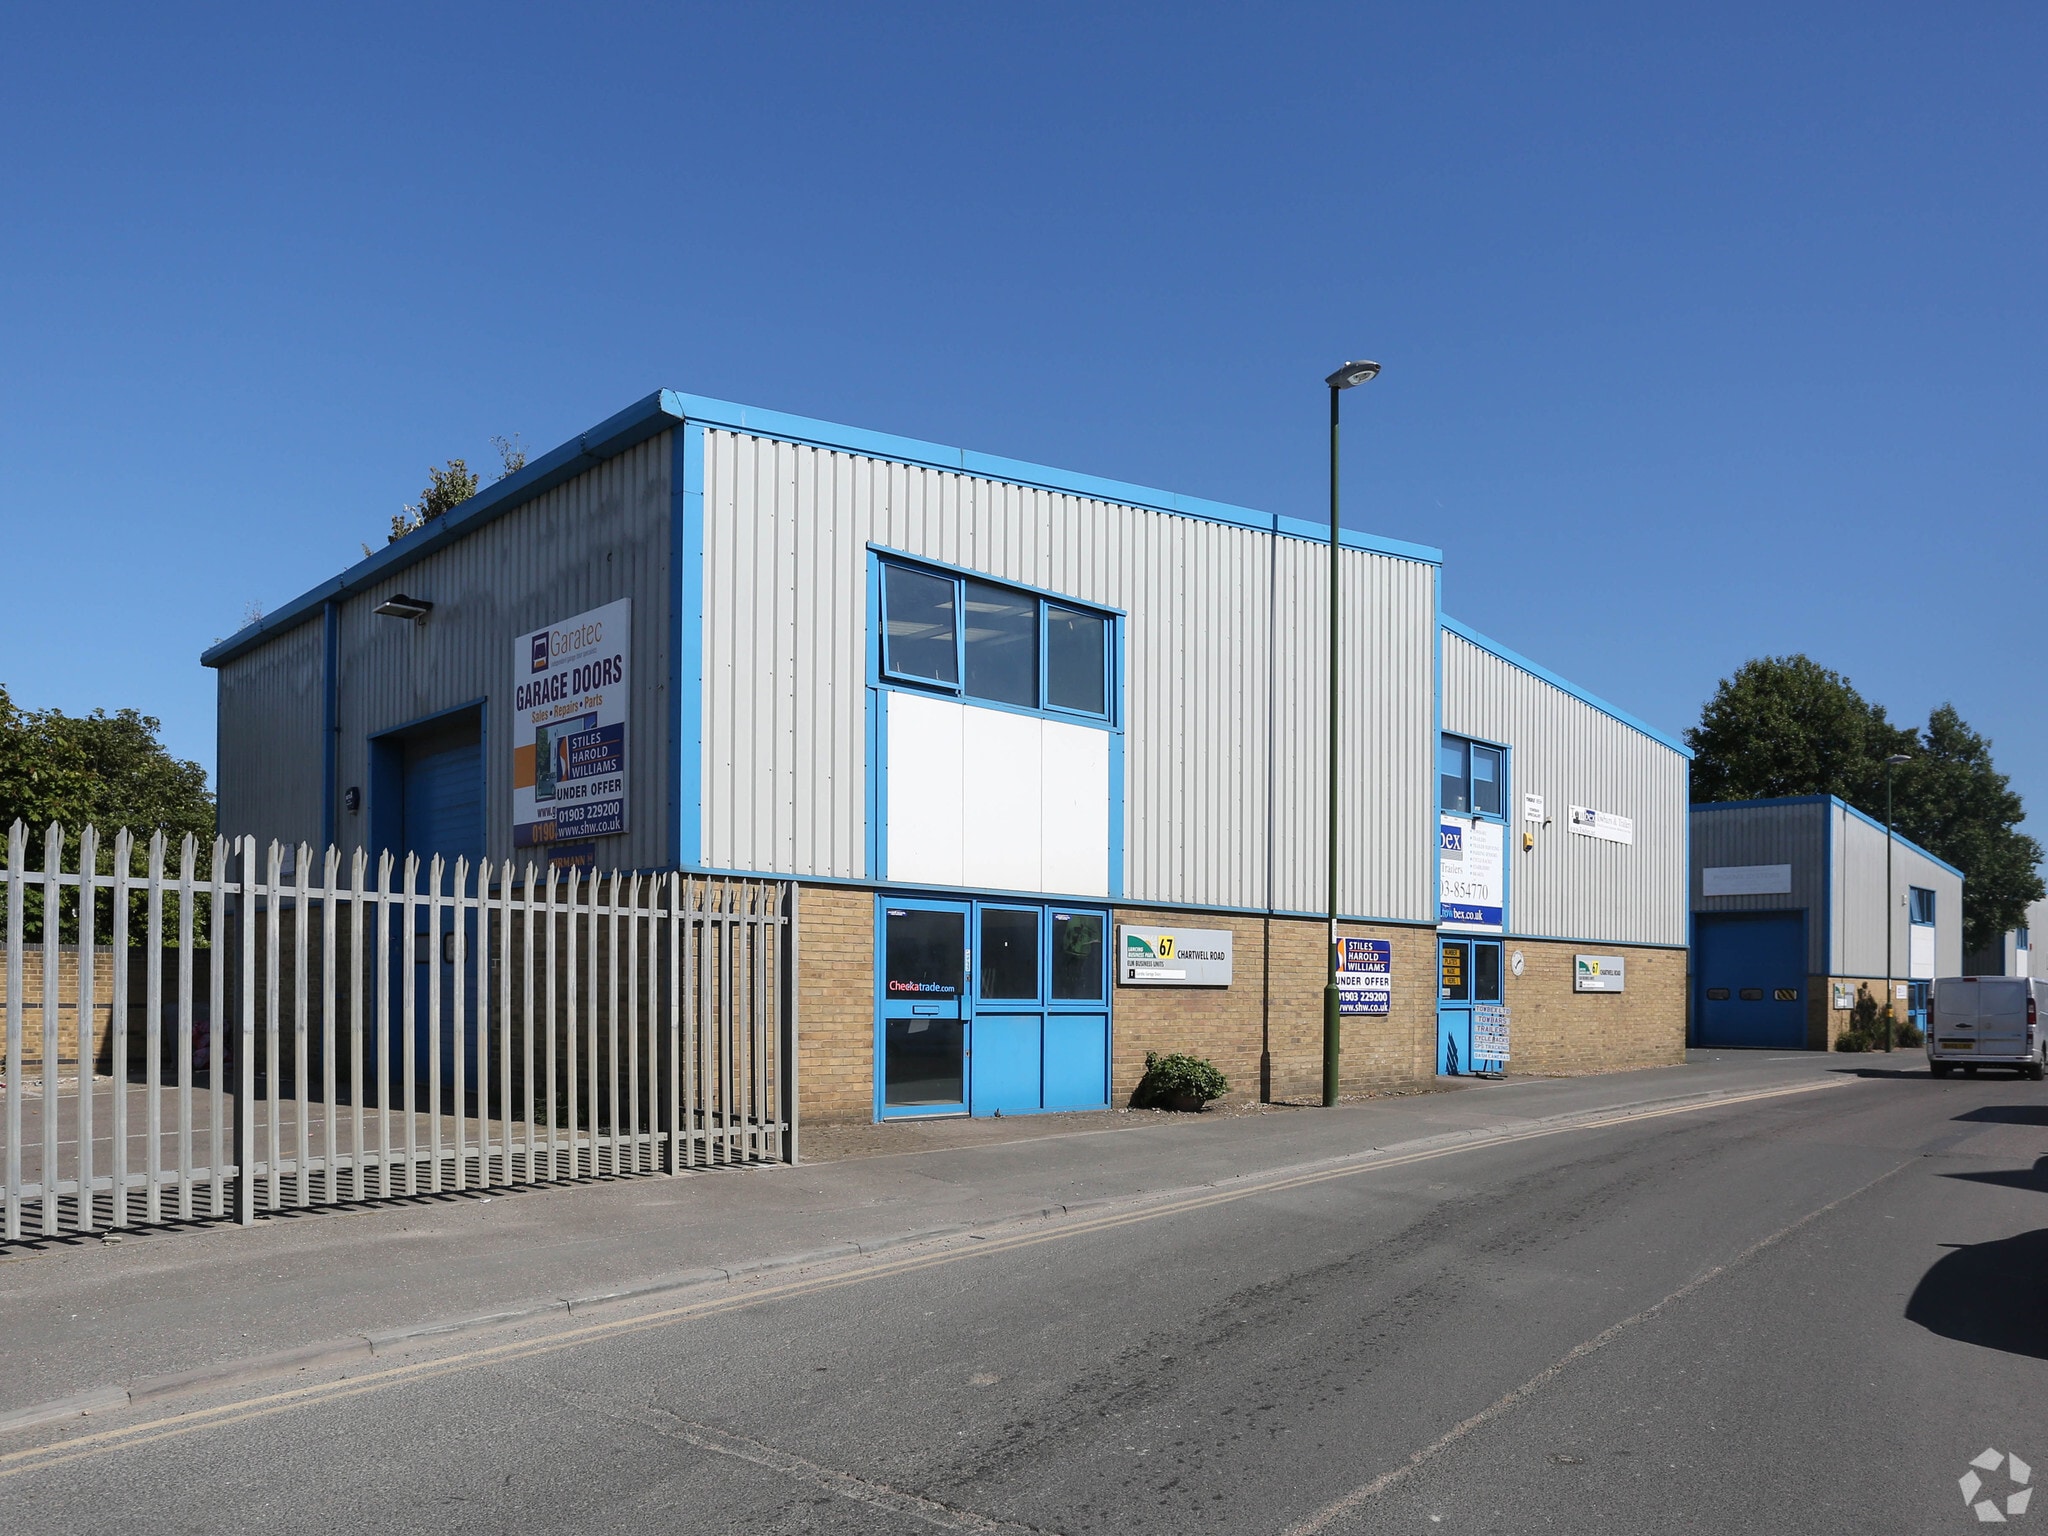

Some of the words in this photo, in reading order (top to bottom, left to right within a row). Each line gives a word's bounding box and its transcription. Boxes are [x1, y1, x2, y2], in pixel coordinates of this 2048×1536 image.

[550, 622, 602, 656] Garatec
[516, 672, 568, 711] GARAGE
[572, 654, 622, 695] DOORS
[531, 710, 548, 724] Sales
[554, 701, 578, 717] Repairs
[584, 694, 603, 709] Parts
[572, 732, 601, 749] STILES
[572, 746, 608, 763] HAROLD
[572, 759, 617, 778] WILLIAMS
[557, 784, 587, 801] UNDER
[591, 779, 621, 795] OFFER
[559, 808, 584, 823] 01903
[587, 801, 620, 819] 229200
[558, 816, 621, 837] www.shw.co.uk
[1441, 862, 1463, 875] Trailers
[1160, 939, 1173, 956] 67
[1349, 941, 1373, 951] STILES
[1177, 950, 1209, 960] CHARTWELL
[1210, 951, 1225, 960] ROAD
[1348, 952, 1379, 961] HAROLD
[1348, 962, 1385, 972] WILLIAMS
[889, 980, 955, 992] Checkatrade.com
[1336, 976, 1361, 986] UNDER
[1365, 977, 1389, 986] OFFER
[1360, 992, 1388, 1002] 229200
[1476, 1005, 1496, 1013] TOWBEX
[1497, 1007, 1511, 1015] LTD
[1478, 1016, 1507, 1024] TOWBARS
[1477, 1025, 1508, 1034] TRAILERS
